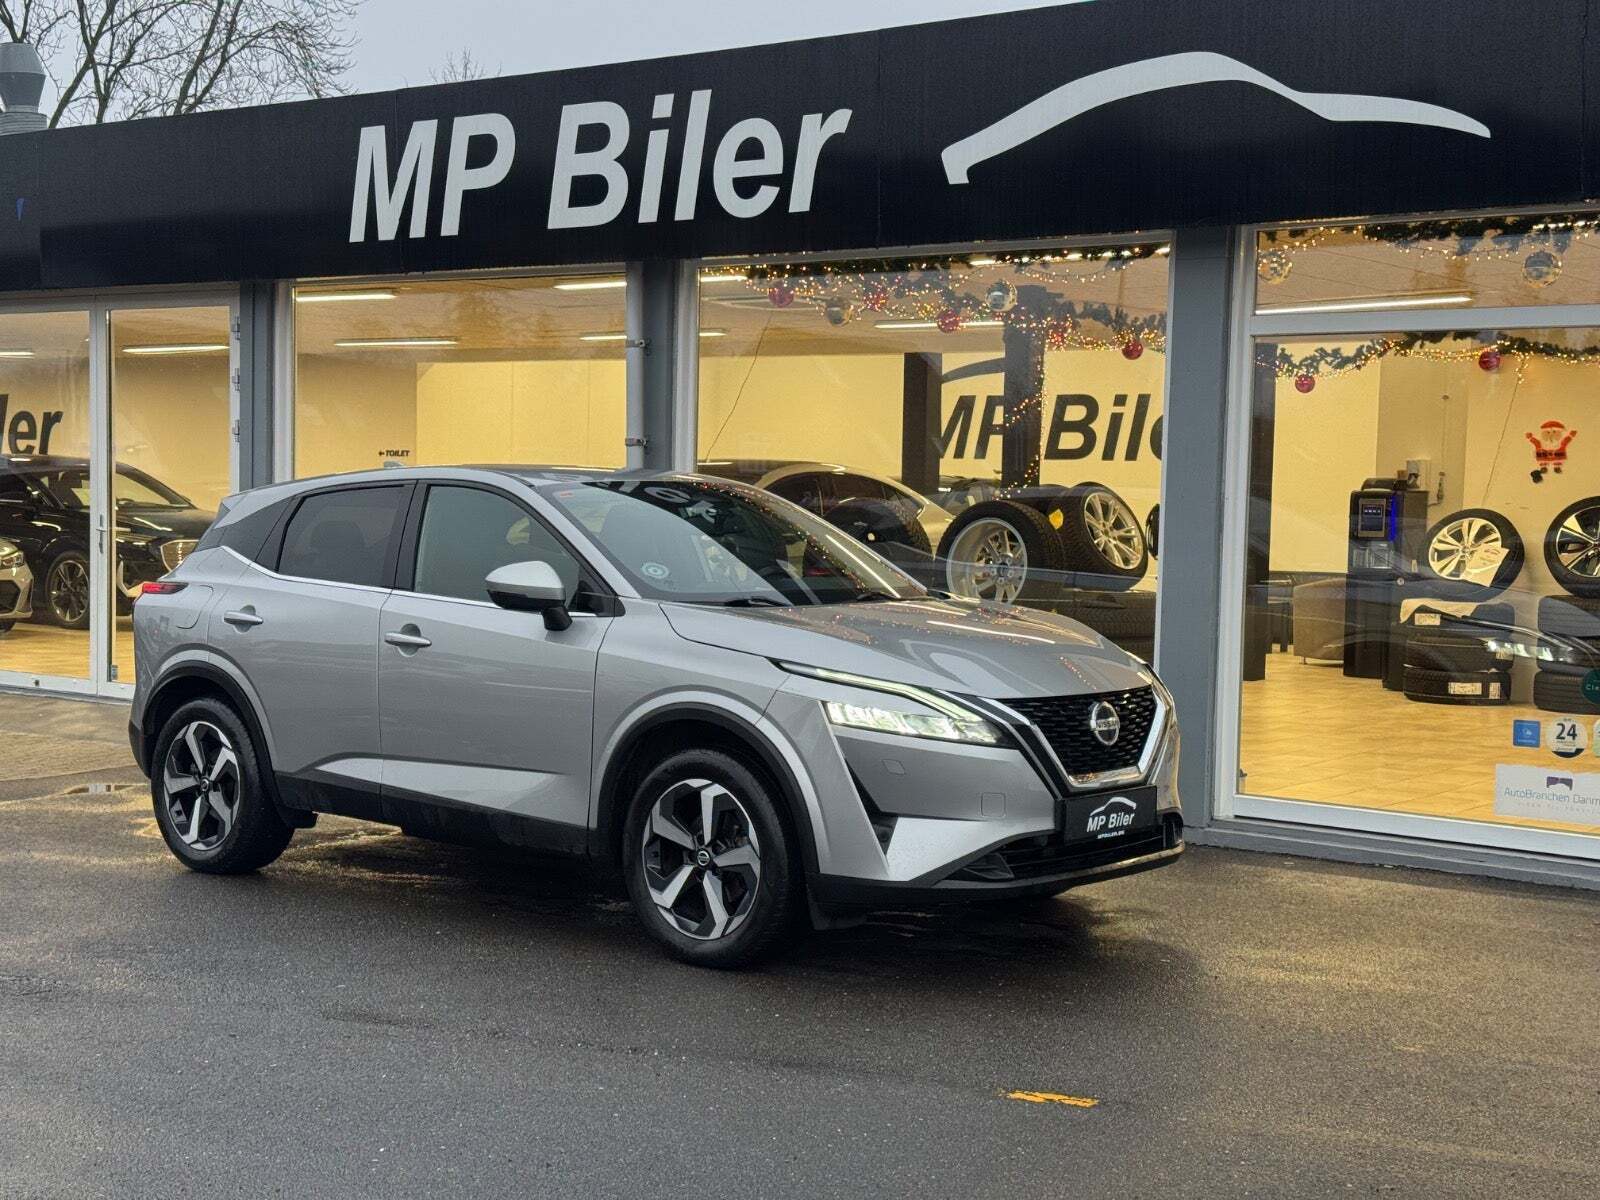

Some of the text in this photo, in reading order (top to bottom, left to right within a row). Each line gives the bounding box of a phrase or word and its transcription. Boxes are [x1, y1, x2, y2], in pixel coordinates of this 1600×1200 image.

[349, 89, 852, 243] MP Biler
[385, 449, 410, 457] TOILET
[1556, 722, 1577, 740] 24
[1504, 787, 1569, 802] AutoBranchen
[1086, 812, 1135, 833] MP Biler
